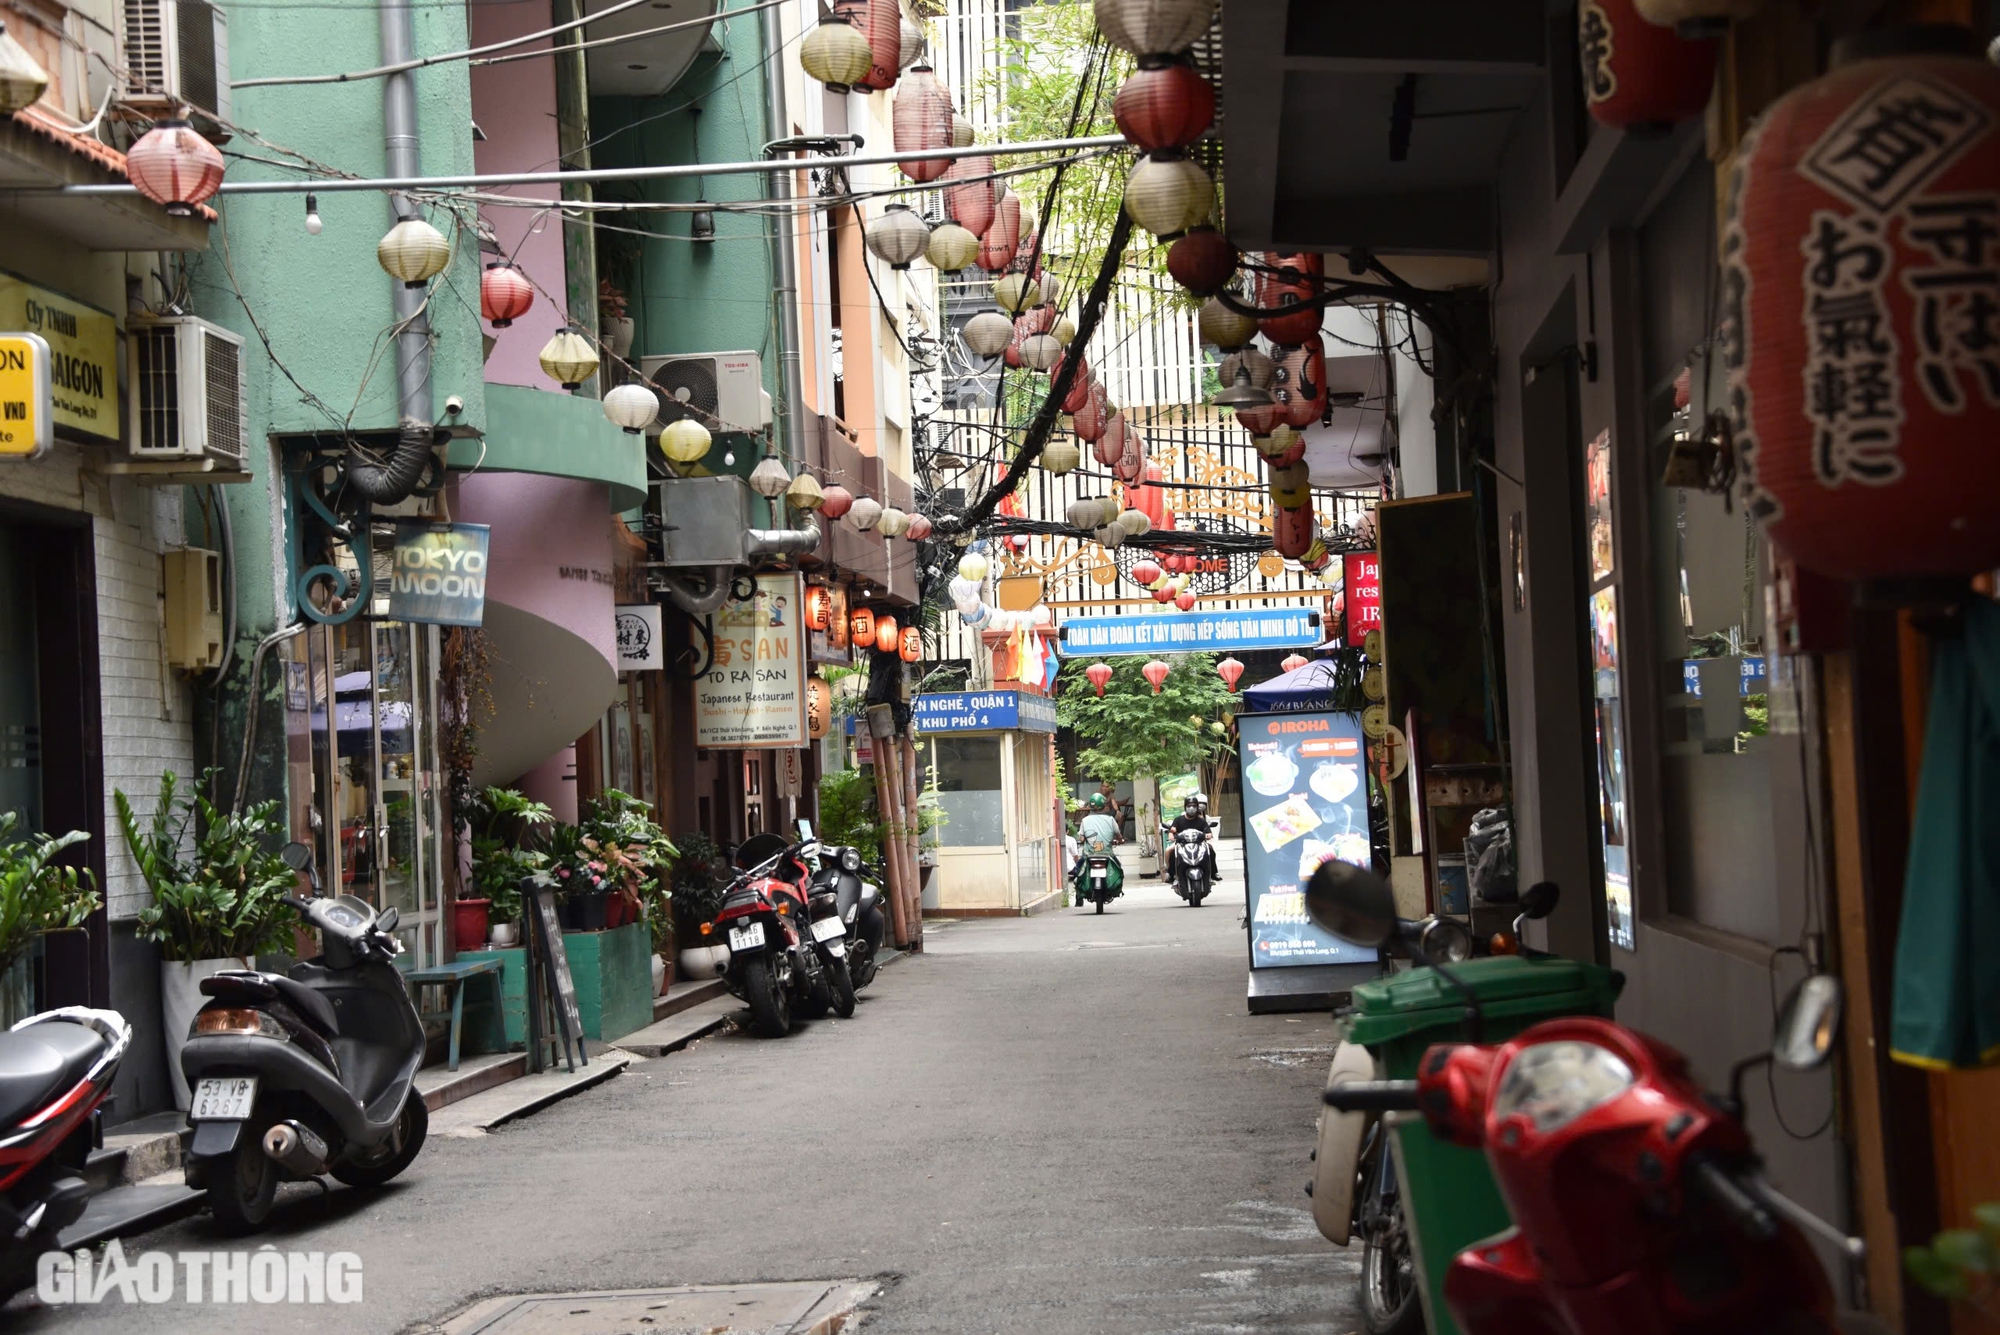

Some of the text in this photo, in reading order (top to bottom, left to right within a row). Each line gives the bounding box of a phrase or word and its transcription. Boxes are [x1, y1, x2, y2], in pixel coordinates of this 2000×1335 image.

[46, 306, 77, 338] TNHH
[4, 402, 26, 421] VND
[394, 545, 485, 573] TOKYO
[390, 571, 485, 599] MOON
[1355, 585, 1379, 598] res
[816, 589, 829, 625] 寿司
[1090, 625, 1109, 646] DÂN
[1110, 623, 1134, 645] ĐOÀN
[1135, 621, 1151, 643] KẾT
[1153, 621, 1170, 642] XÂY
[1170, 622, 1196, 644] DỰNG
[1197, 618, 1214, 640] NẾP
[1215, 617, 1239, 639] SỐNG
[1241, 617, 1259, 639] VĂN
[1260, 618, 1284, 638] MINH
[1286, 615, 1298, 636] ĐÔ
[904, 634, 919, 652] 酒
[707, 668, 787, 683] TO RA SAN
[700, 690, 794, 706] Japanese Restaurant
[930, 695, 968, 712] NGHÉ,
[970, 694, 1004, 710] QUẬN
[1007, 696, 1015, 707] 1
[1270, 701, 1292, 711] 1664
[703, 707, 727, 716] Sushi
[765, 705, 793, 714] Ramen
[922, 717, 948, 728] KHU
[951, 710, 977, 727] PHỐ
[980, 715, 989, 726] 4
[1281, 719, 1330, 733] IROHA
[736, 935, 760, 949] 1118
[200, 1099, 243, 1115] 6267
